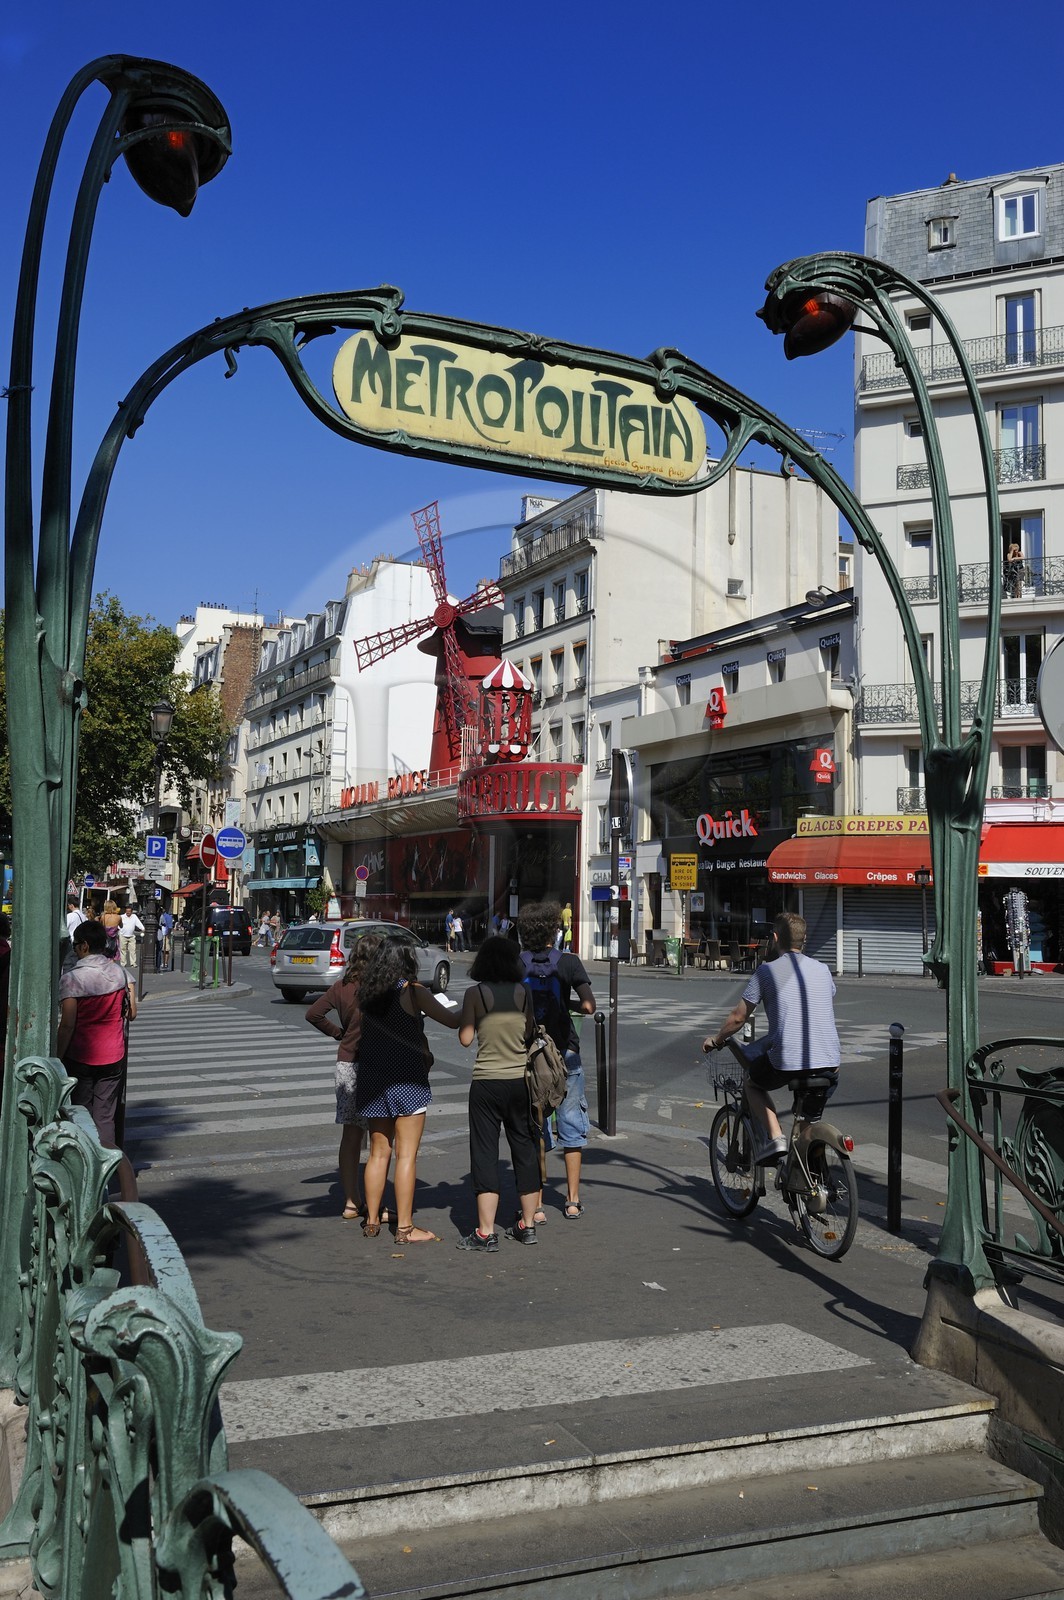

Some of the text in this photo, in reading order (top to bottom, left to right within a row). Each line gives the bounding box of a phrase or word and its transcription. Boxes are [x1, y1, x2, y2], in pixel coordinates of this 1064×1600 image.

[351, 338, 693, 462] METROPOLITAIN
[821, 636, 841, 648] Quick
[768, 651, 786, 662] Quick
[723, 663, 739, 674] Quick
[676, 675, 692, 686] Quick
[709, 692, 721, 712] Q
[820, 752, 833, 770] Q
[341, 781, 378, 809] MOULIN
[388, 769, 428, 801] ROUGE
[479, 771, 582, 813] ROUGE
[697, 810, 758, 847] Quick
[799, 819, 843, 833] GLACES
[846, 820, 904, 831] CREPES
[152, 840, 161, 854] P
[698, 860, 714, 871] uality
[717, 860, 736, 870] Burger
[772, 871, 806, 880] Sandwichs
[814, 872, 838, 880] Glaces
[866, 871, 898, 883] Crêpes
